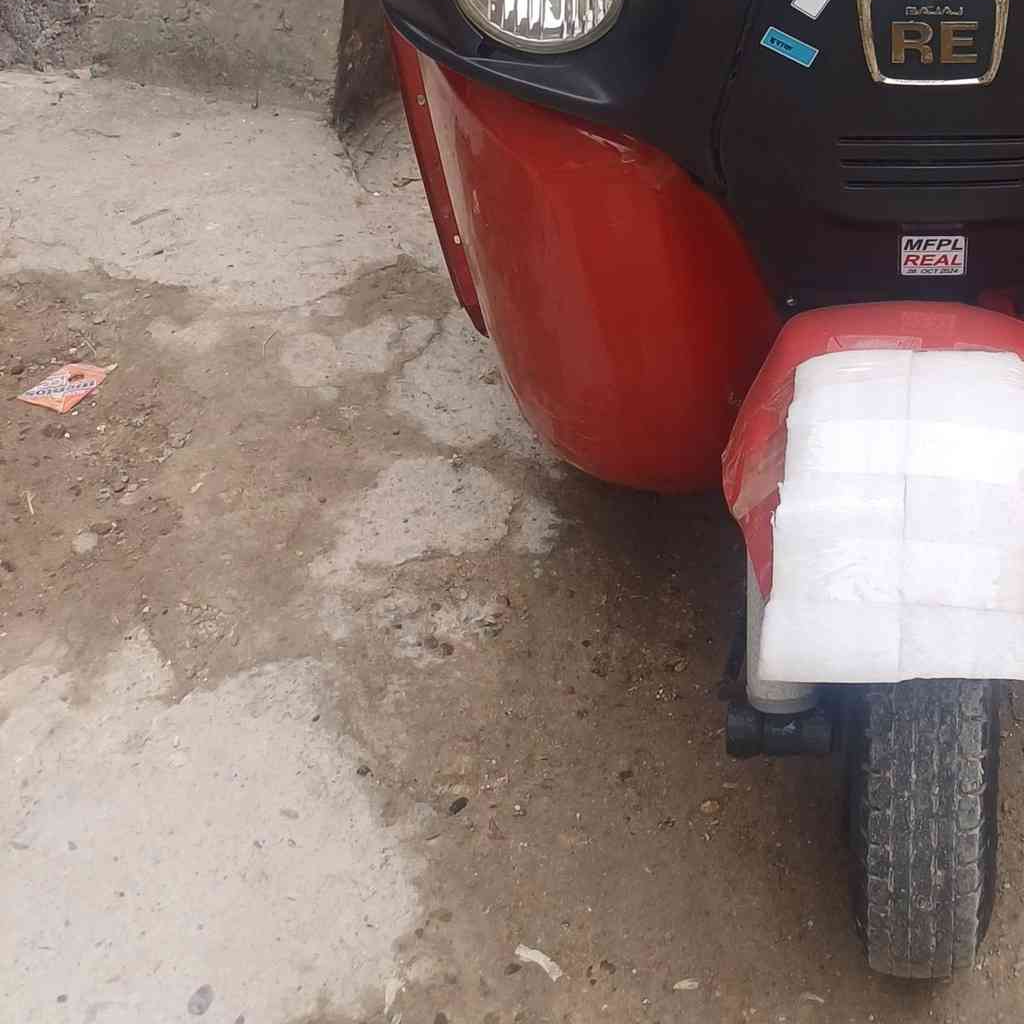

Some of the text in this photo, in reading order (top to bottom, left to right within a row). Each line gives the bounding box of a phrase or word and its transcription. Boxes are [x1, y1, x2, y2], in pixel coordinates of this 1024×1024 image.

[891, 21, 978, 64] RE
[903, 239, 963, 251] MFPL
[903, 254, 963, 266] REAL
